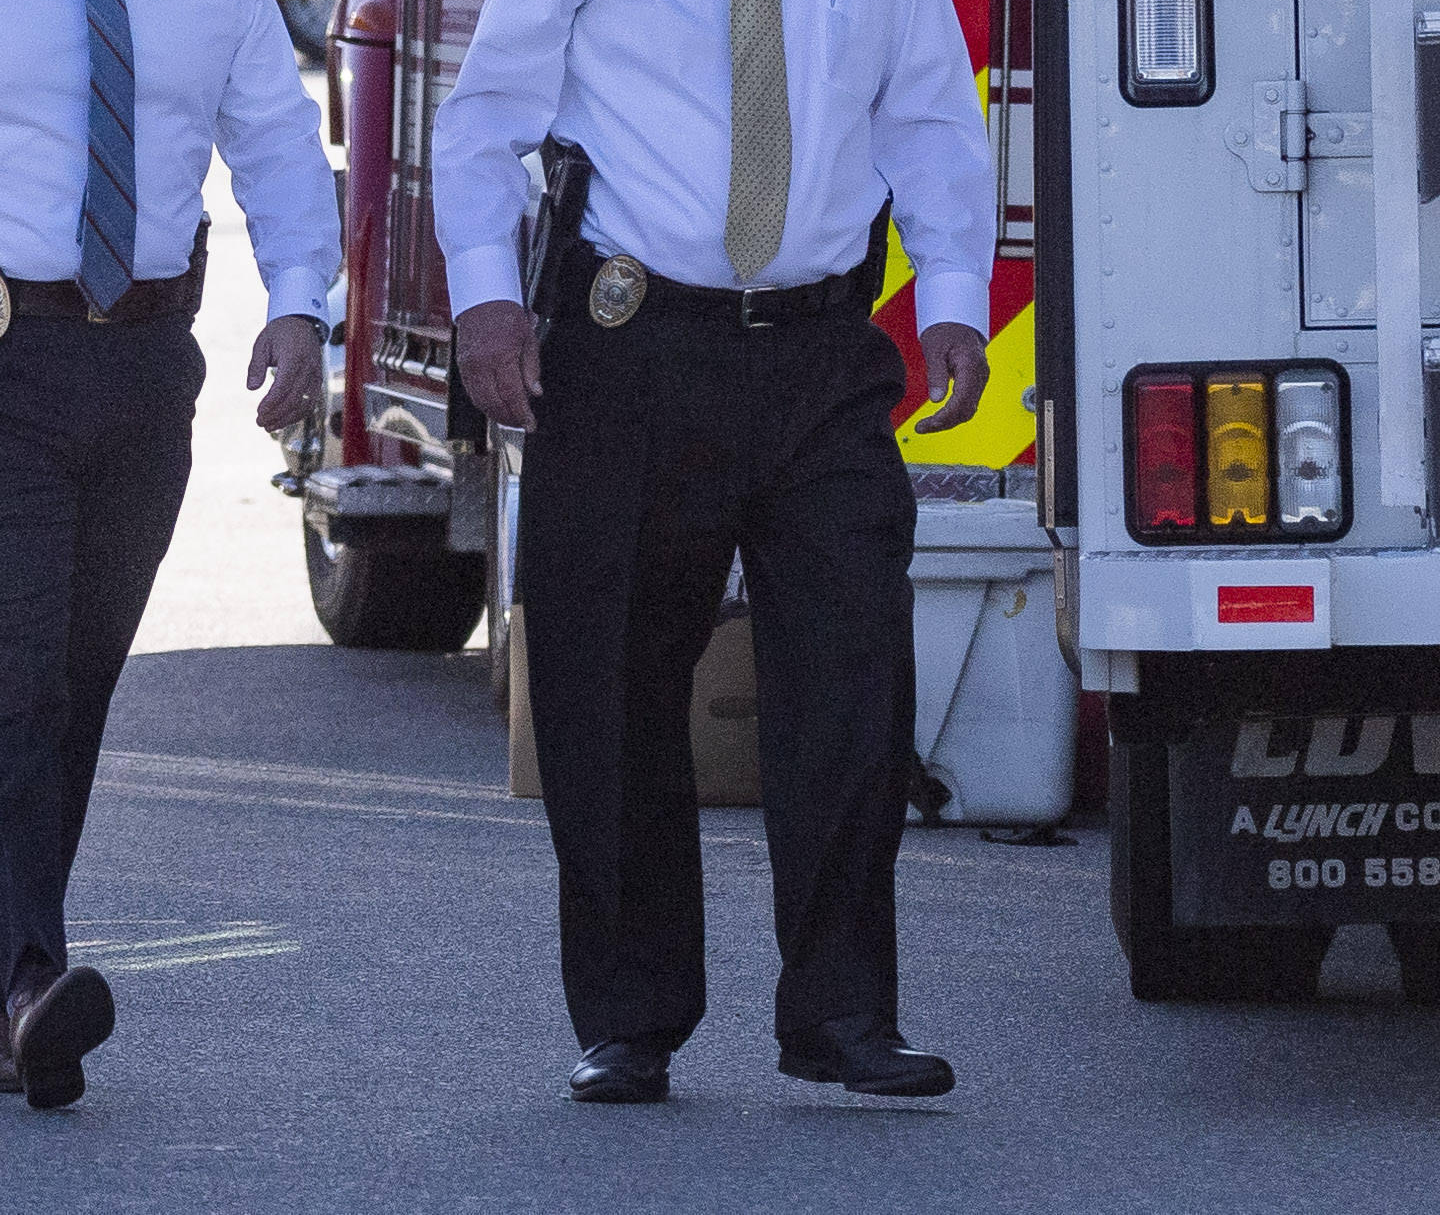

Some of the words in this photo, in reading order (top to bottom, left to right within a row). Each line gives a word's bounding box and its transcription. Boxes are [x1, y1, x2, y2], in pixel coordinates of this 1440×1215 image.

[1231, 806, 1257, 834] A
[1264, 803, 1388, 842] LYNCH
[1268, 859, 1346, 889] 800
[1365, 857, 1440, 886] 558
